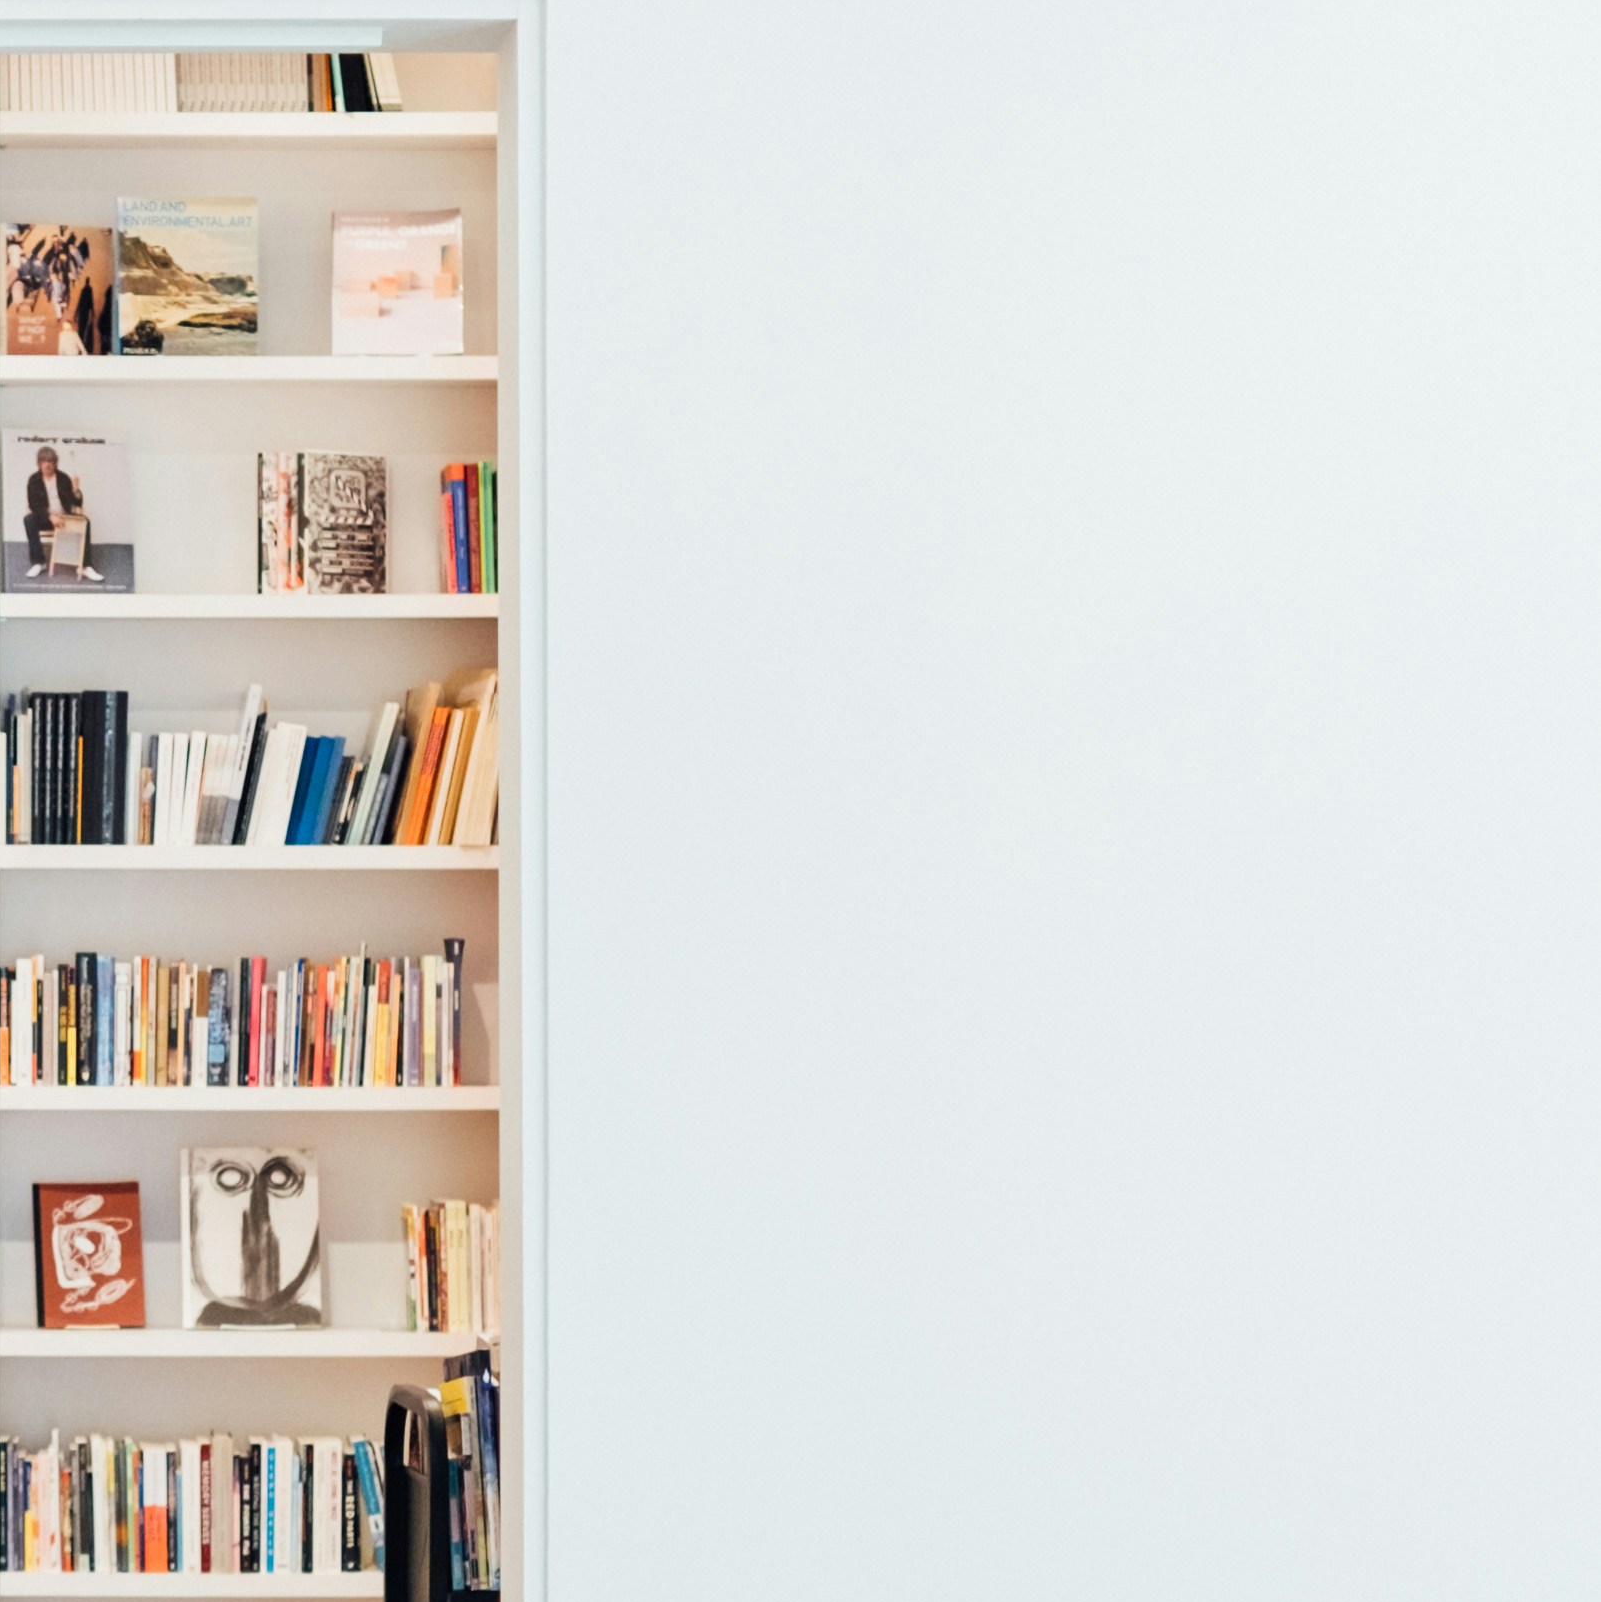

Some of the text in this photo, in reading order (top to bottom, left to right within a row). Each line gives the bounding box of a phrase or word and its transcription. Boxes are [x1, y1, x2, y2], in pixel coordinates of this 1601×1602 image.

[122, 200, 186, 214] LAND AND
[122, 215, 253, 228] ENVIRONMENTAL ART
[345, 1495, 356, 1519] RED
